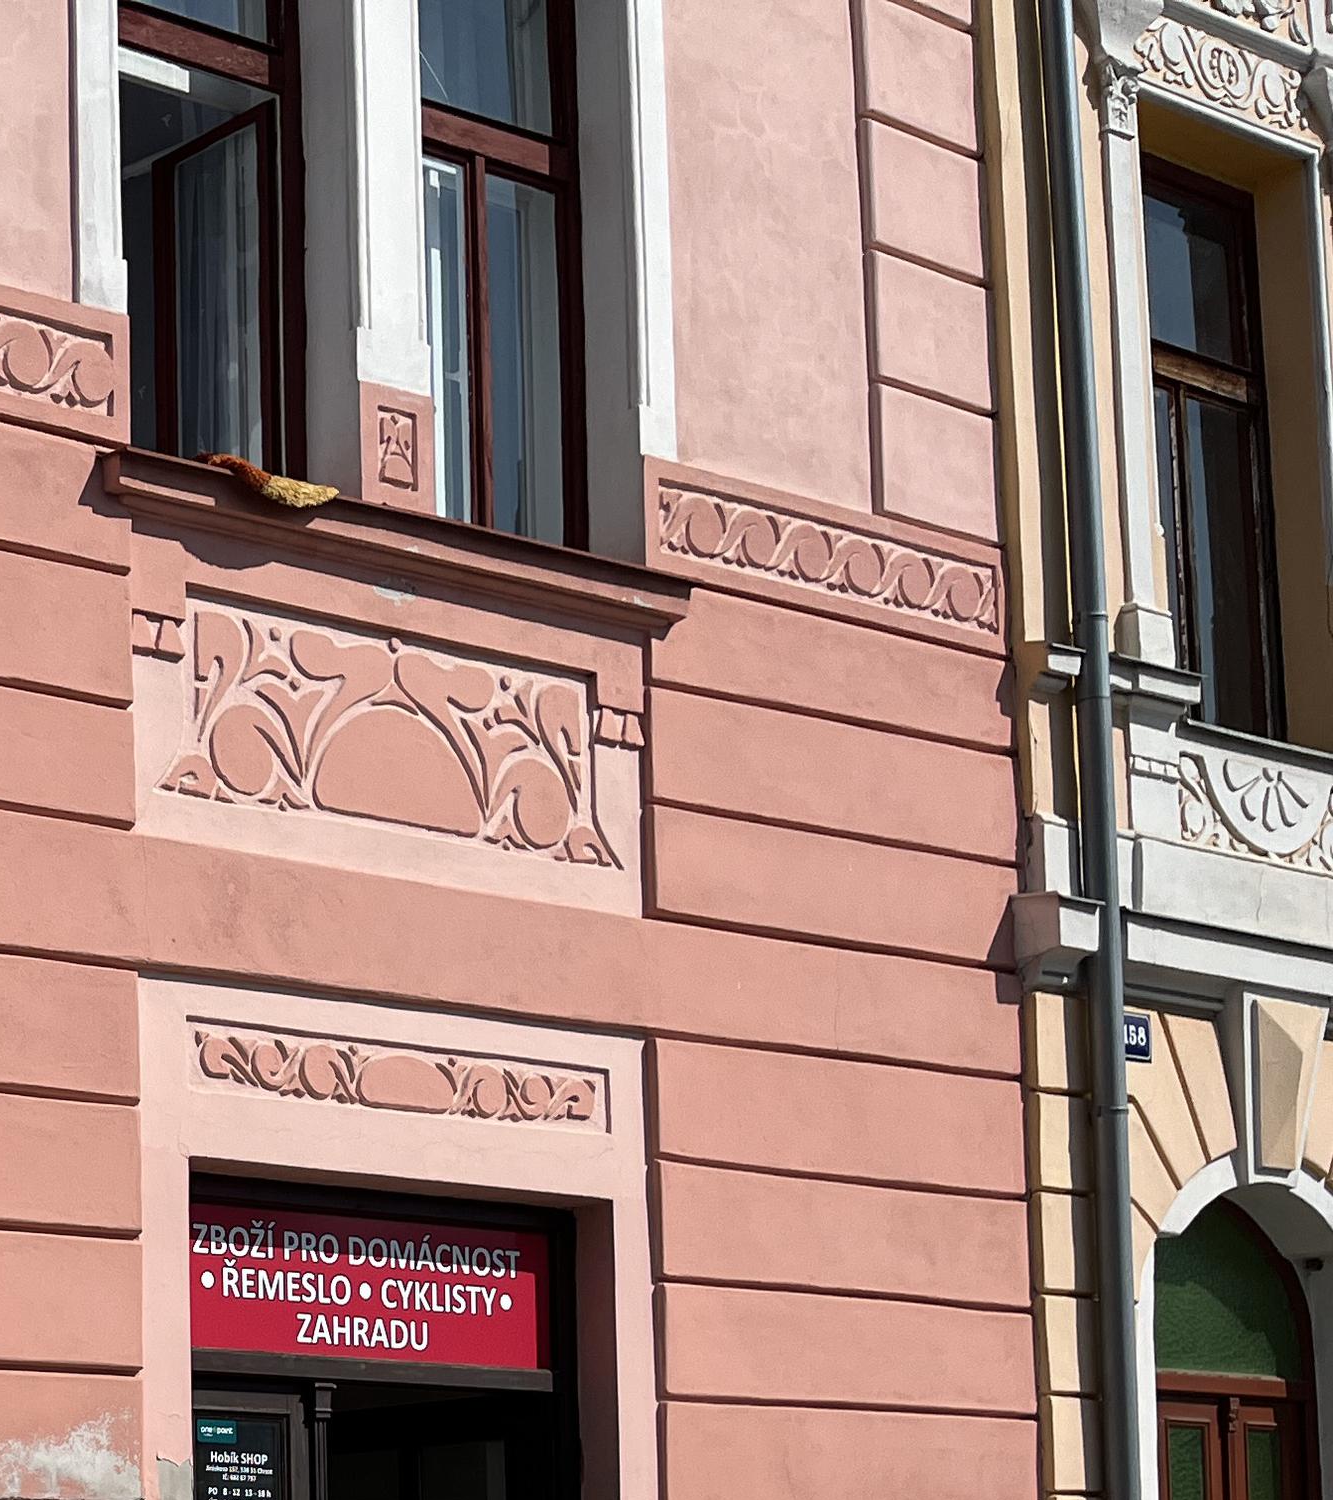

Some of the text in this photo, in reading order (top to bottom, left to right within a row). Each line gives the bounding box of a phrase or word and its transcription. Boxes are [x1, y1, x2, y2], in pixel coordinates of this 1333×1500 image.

[192, 1220, 521, 1279] ZBOŽÍ PRO DOMÁCNOST
[222, 1258, 497, 1316] ŘEMESLO CYKLISTY
[296, 1313, 430, 1351] ZAHRADU
[210, 1451, 268, 1465] Hobík SHOP
